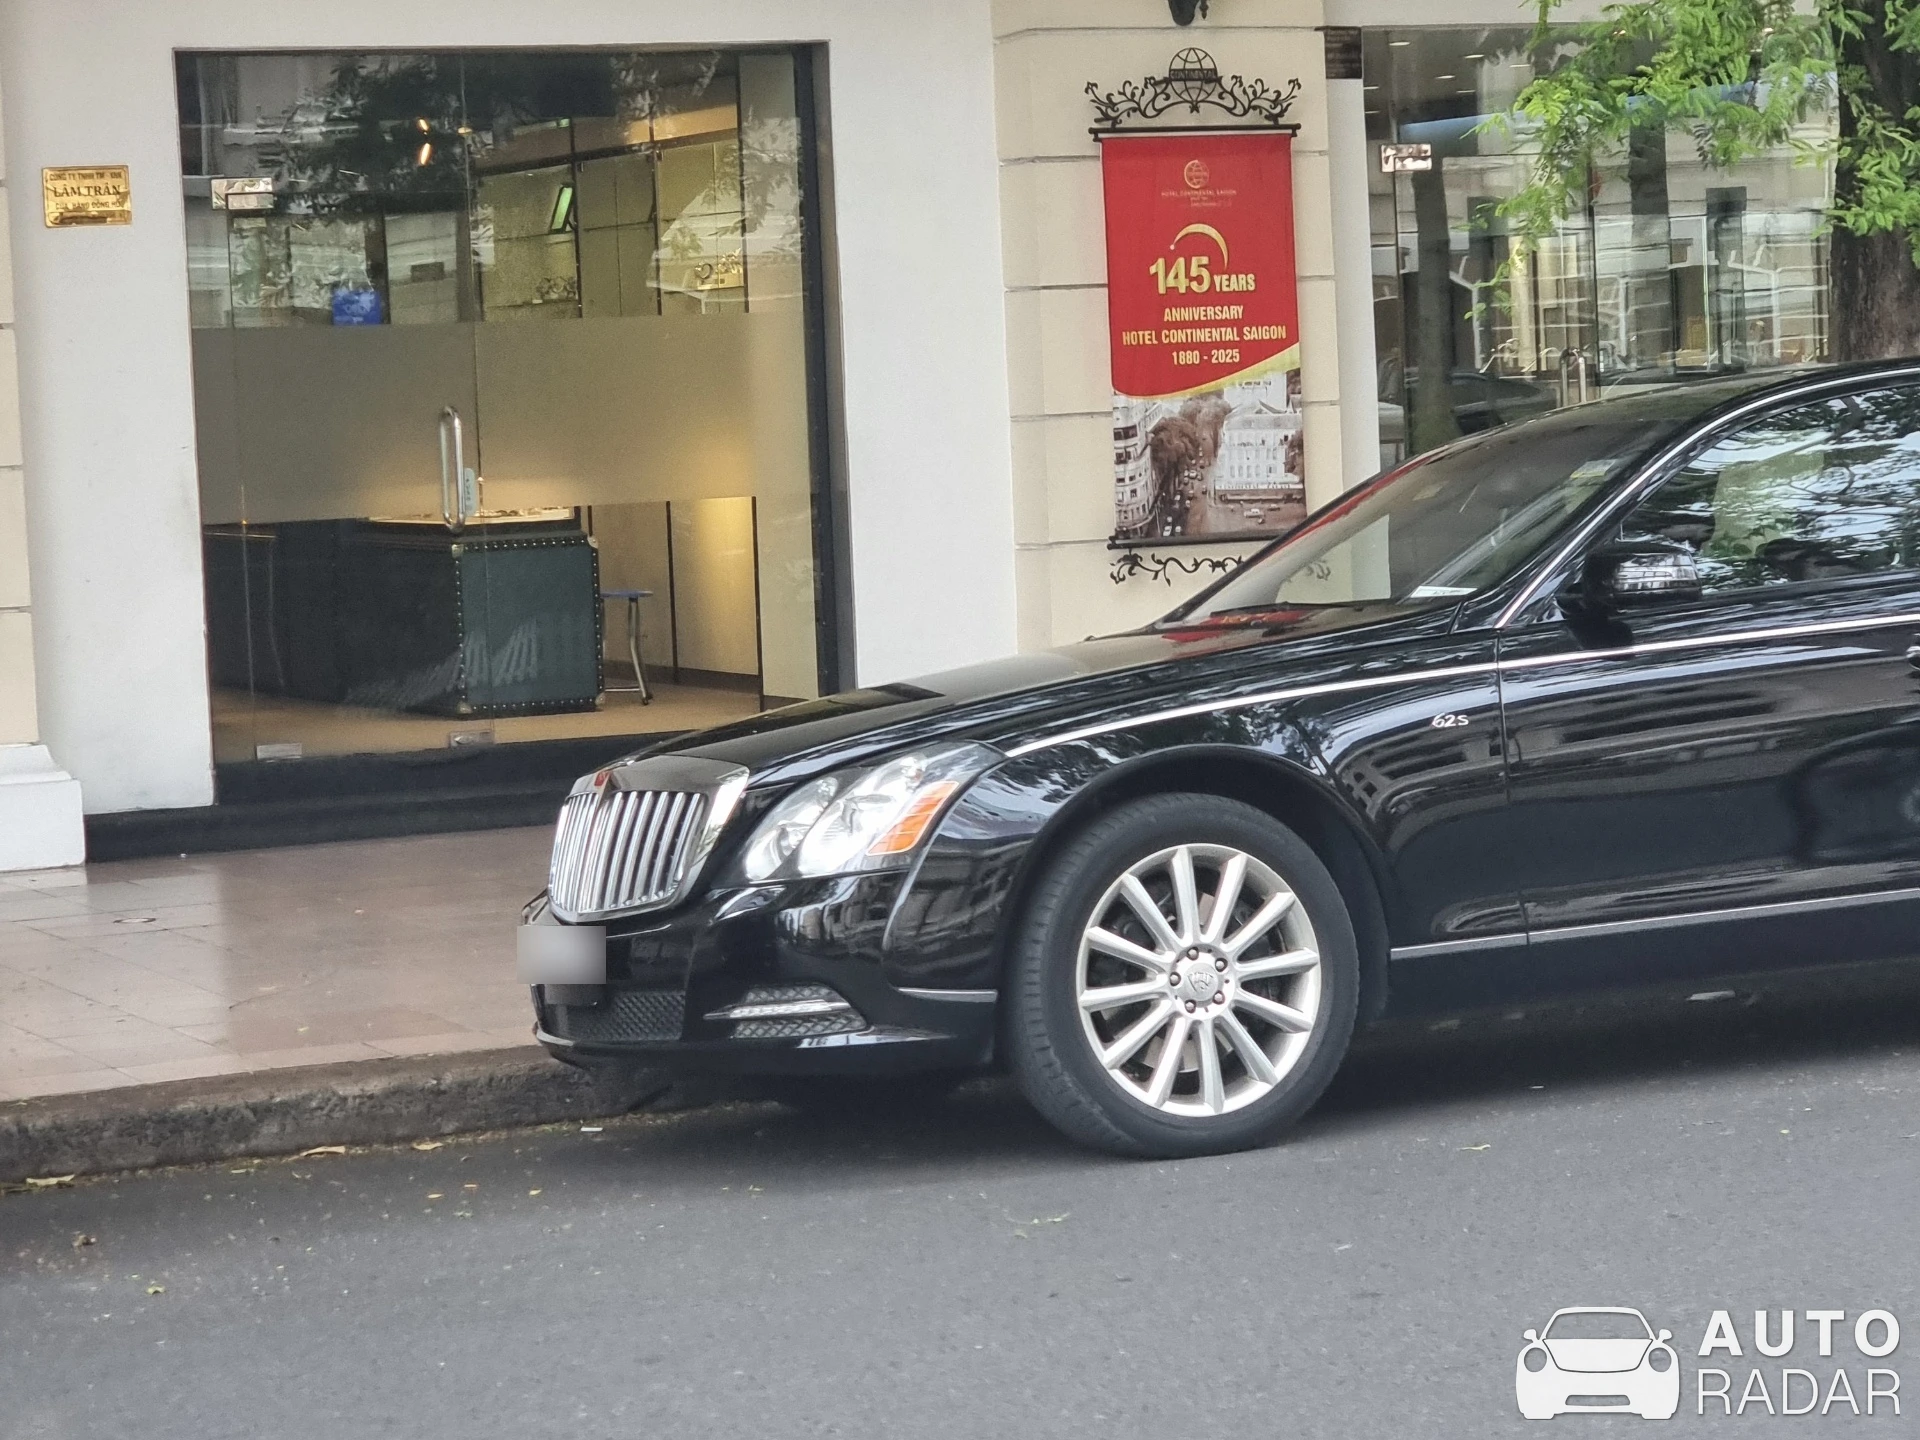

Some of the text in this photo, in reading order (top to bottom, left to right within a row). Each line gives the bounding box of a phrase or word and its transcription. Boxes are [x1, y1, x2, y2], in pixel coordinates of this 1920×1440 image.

[1149, 256, 1255, 294] 145 YEARS
[1163, 305, 1244, 322] ANNIVERSARY
[1122, 325, 1287, 345] HOTEL CONTINENTAL SAIGON
[1172, 350, 1200, 365] 1880
[1211, 349, 1240, 364] 2025
